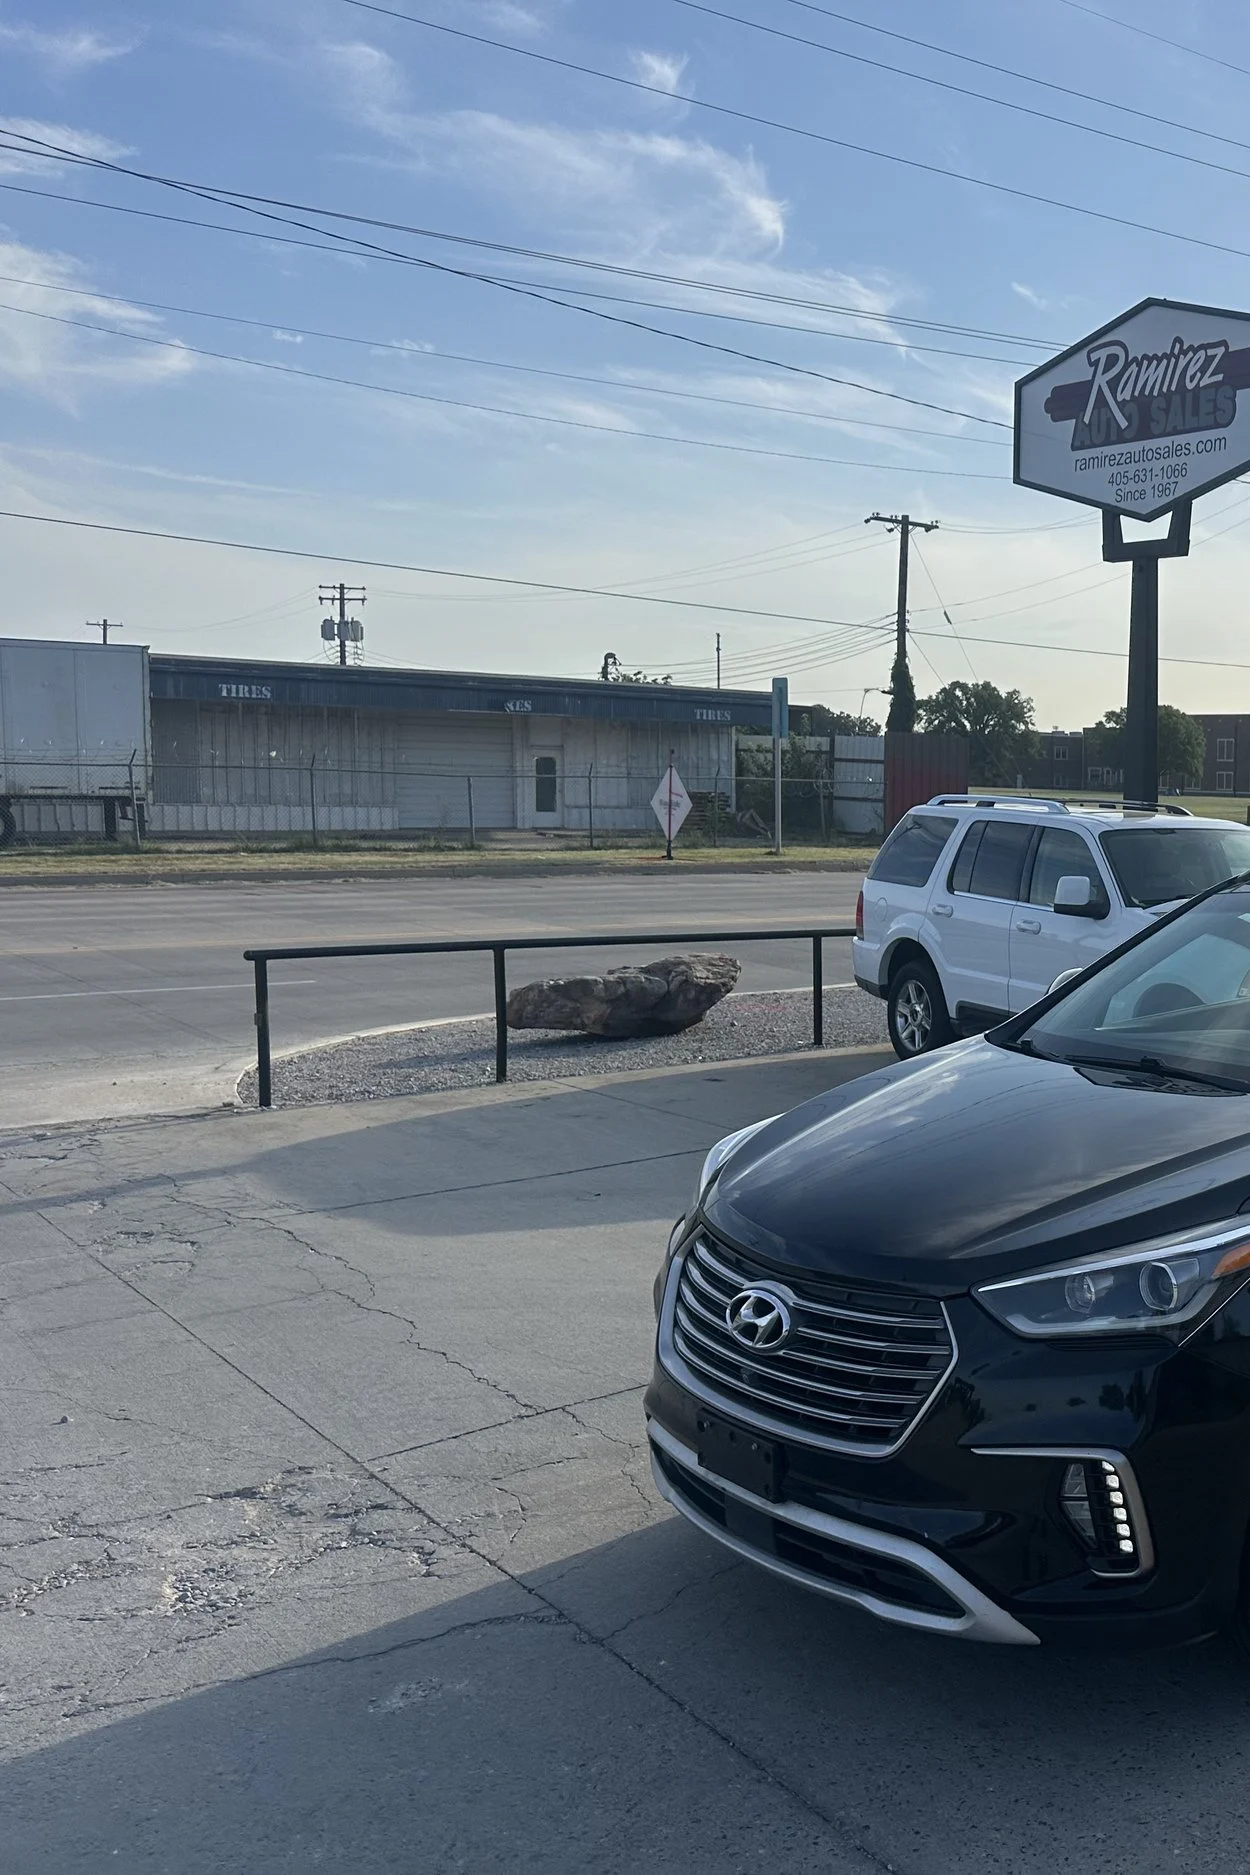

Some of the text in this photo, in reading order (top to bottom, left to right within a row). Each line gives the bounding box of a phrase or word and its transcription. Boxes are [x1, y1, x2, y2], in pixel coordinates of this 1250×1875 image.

[1084, 340, 1227, 430] Ramirez
[1075, 384, 1235, 448] AUTO SALES
[1074, 435, 1228, 472] ramirezautosales.com
[1107, 462, 1188, 487] 405-631-1066
[1114, 481, 1179, 503] Since 1967
[218, 684, 271, 699] TIRES
[694, 709, 731, 721] TIRES
